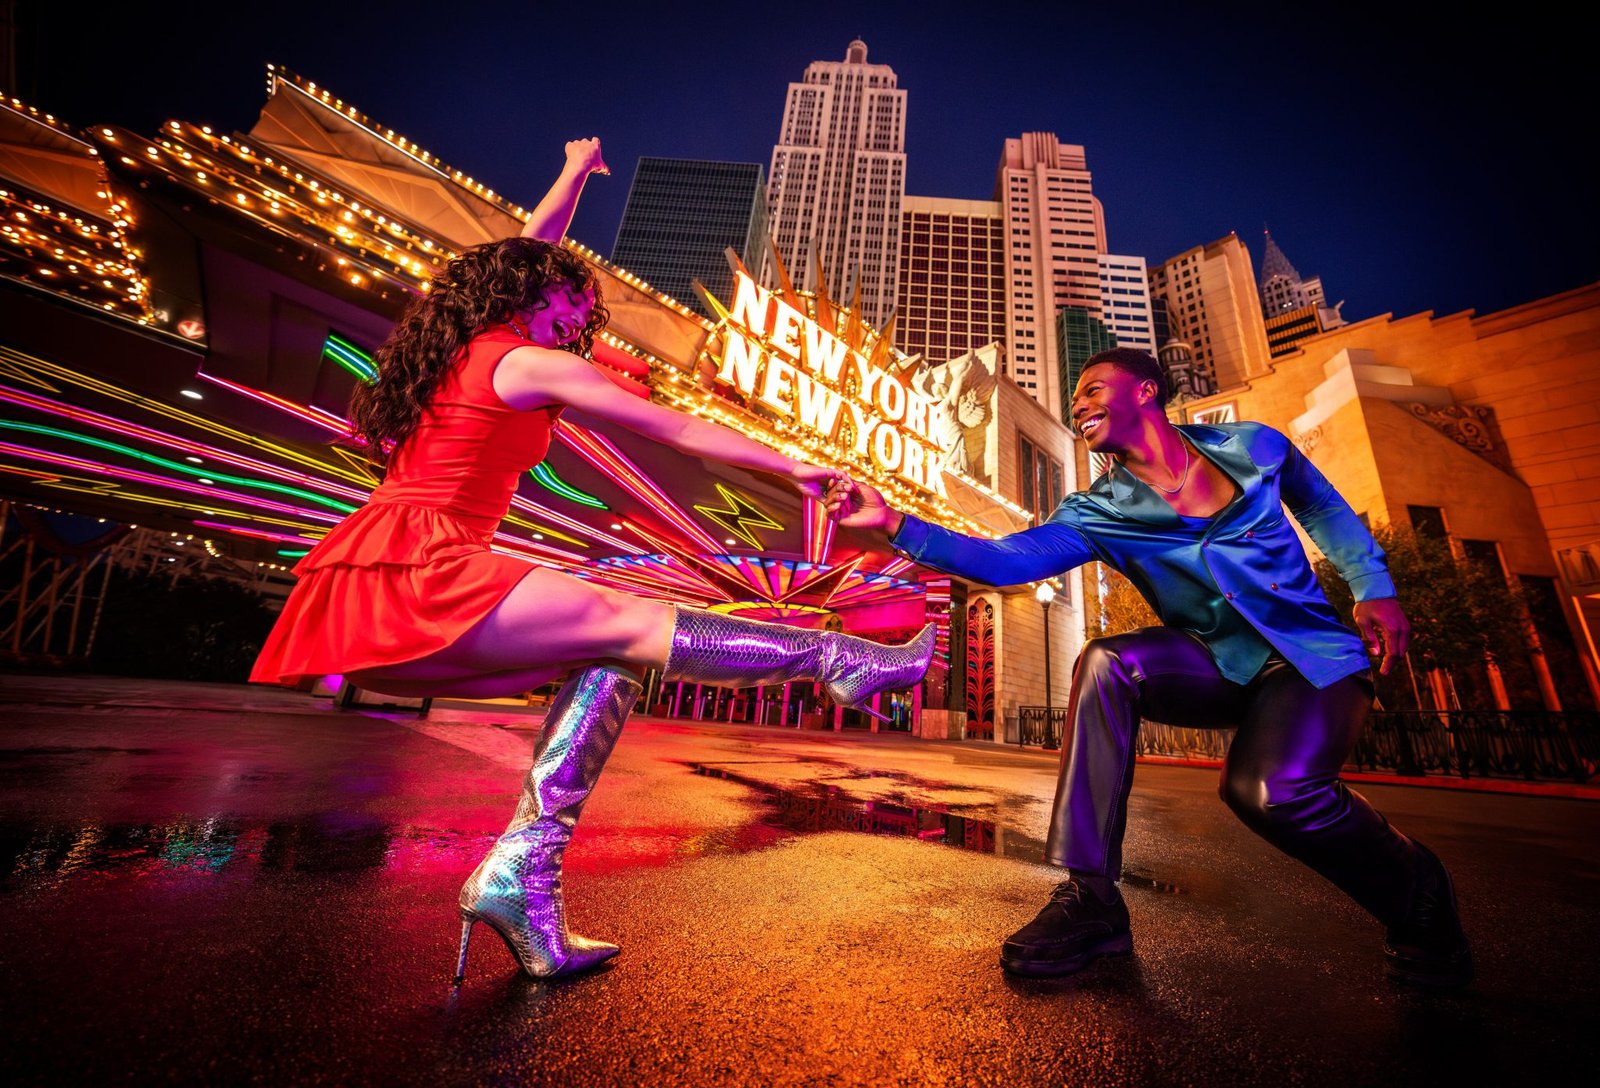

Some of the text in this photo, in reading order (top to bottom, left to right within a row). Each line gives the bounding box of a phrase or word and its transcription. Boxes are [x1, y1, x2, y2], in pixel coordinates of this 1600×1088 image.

[716, 324, 950, 499] NEW YORK
[729, 270, 950, 452] NEW YORK
